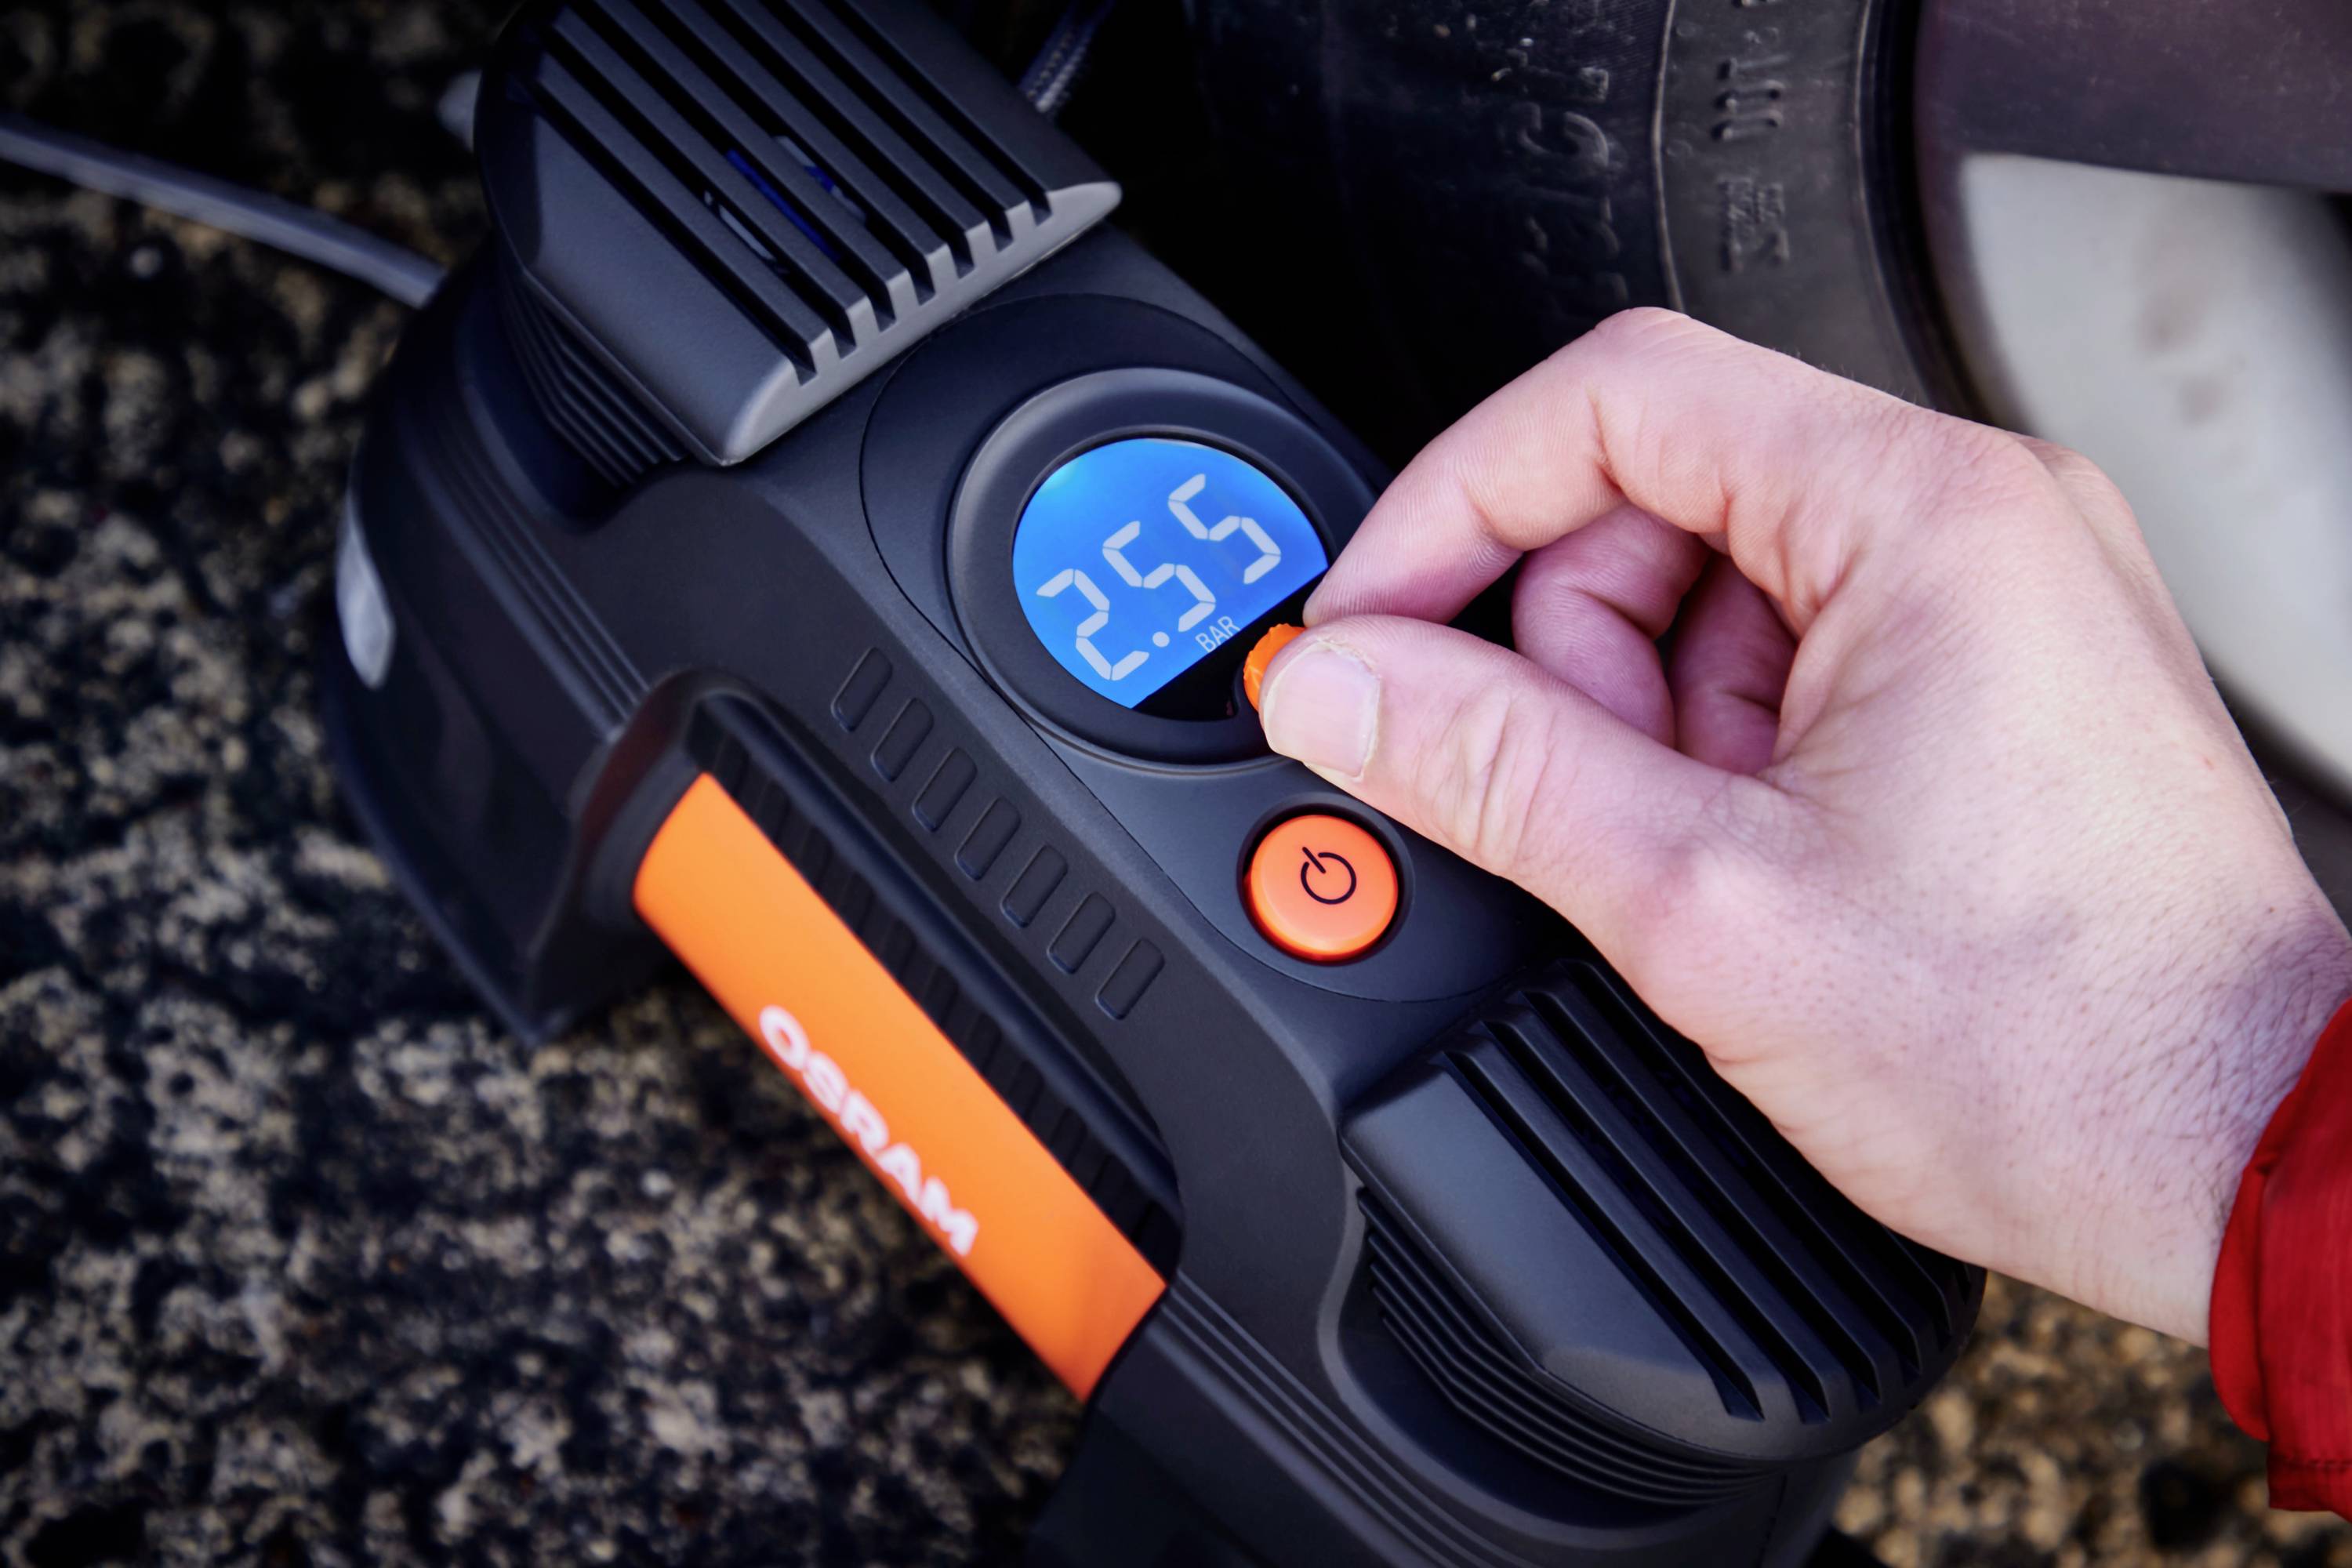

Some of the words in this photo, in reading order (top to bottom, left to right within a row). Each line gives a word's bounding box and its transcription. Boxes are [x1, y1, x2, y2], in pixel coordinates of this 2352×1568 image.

[1036, 474, 1281, 681] 2.55
[1195, 615, 1241, 652] BAR
[760, 1005, 978, 1256] OSRAM
